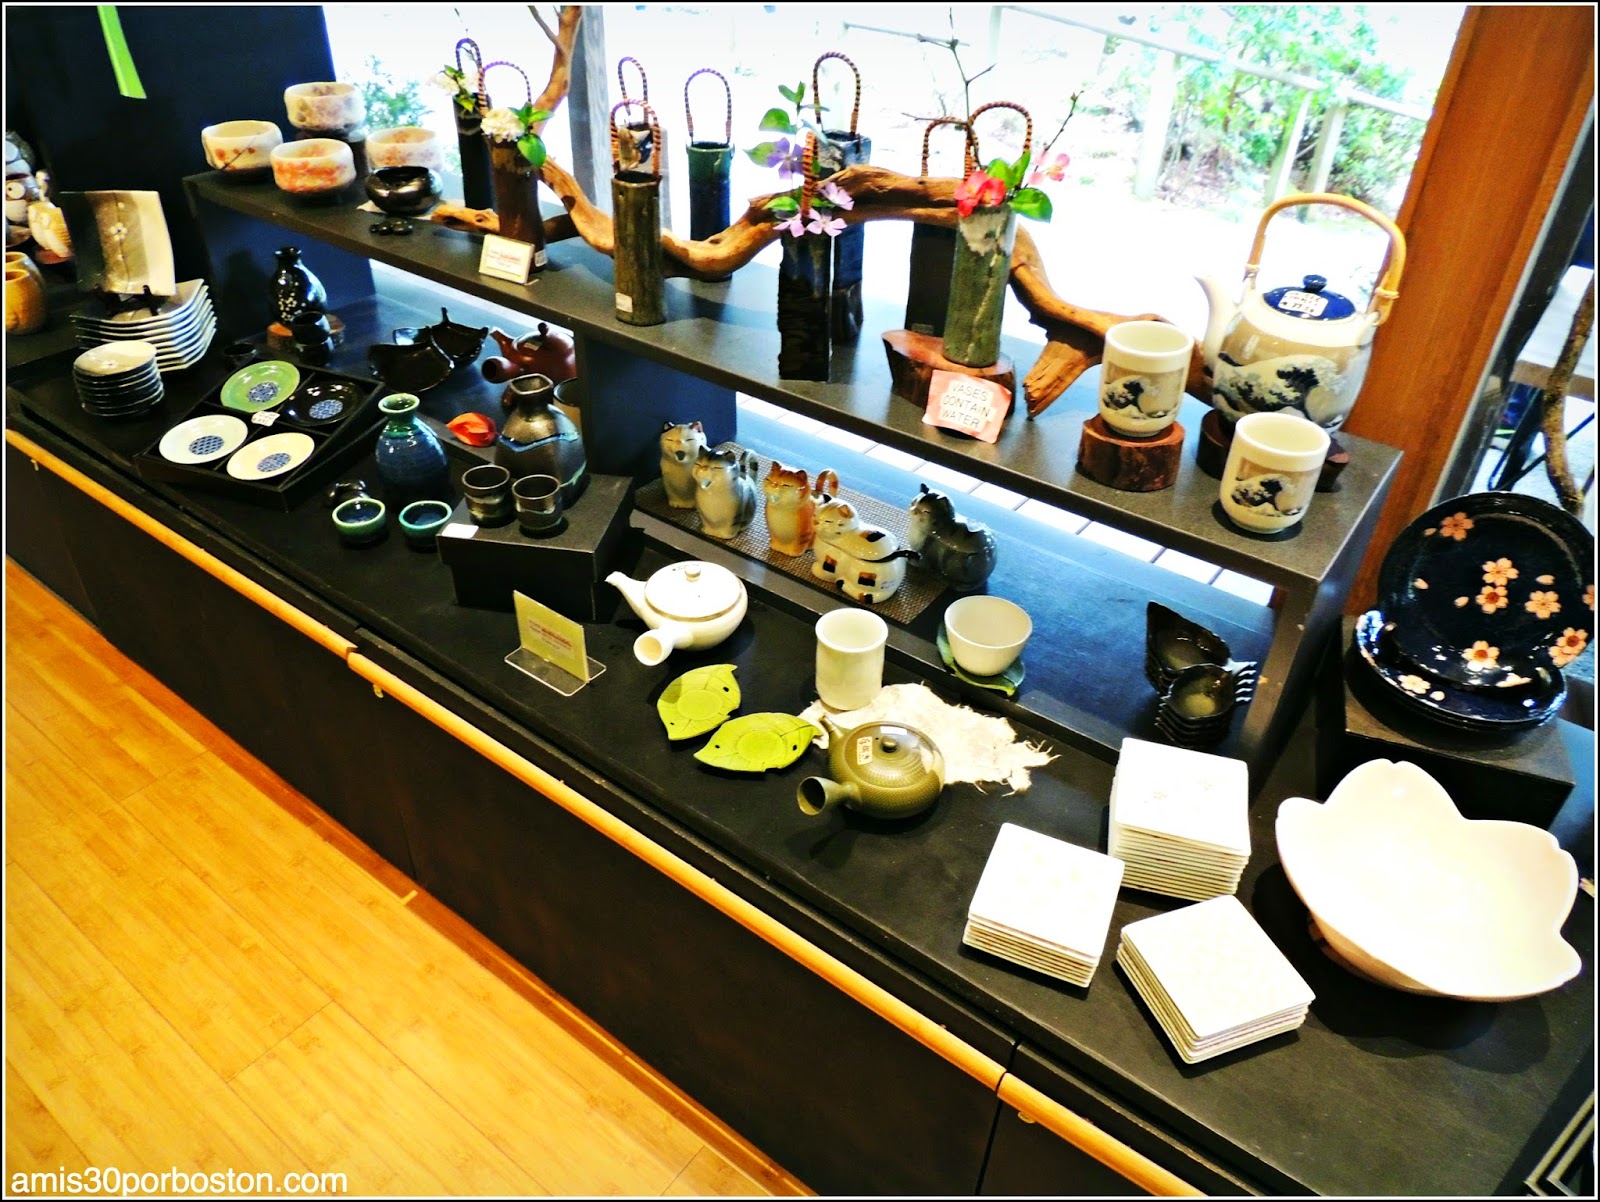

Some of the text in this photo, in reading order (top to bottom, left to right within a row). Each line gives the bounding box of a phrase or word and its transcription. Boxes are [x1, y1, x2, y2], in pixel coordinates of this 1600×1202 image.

[953, 383, 988, 402] VASES
[943, 394, 990, 417] CONTAIN
[942, 409, 980, 428] WATER
